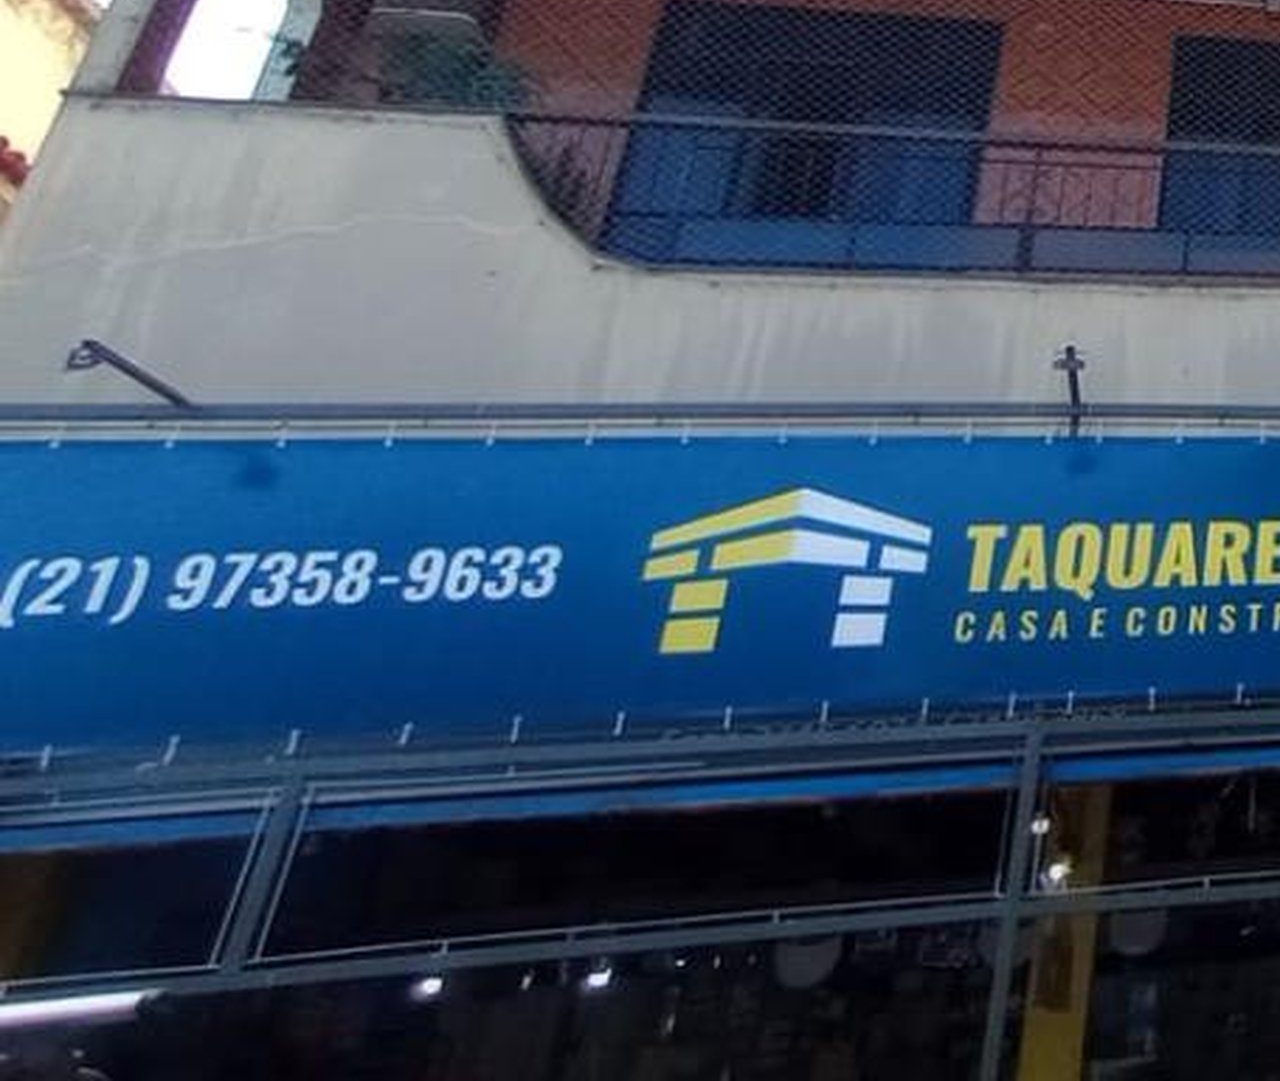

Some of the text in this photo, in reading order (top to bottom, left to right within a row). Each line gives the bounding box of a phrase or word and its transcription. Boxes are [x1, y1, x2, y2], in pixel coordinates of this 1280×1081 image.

[0, 545, 563, 628] (21) 97358-9633
[954, 609, 1069, 644] CASA
[1088, 607, 1108, 639] E
